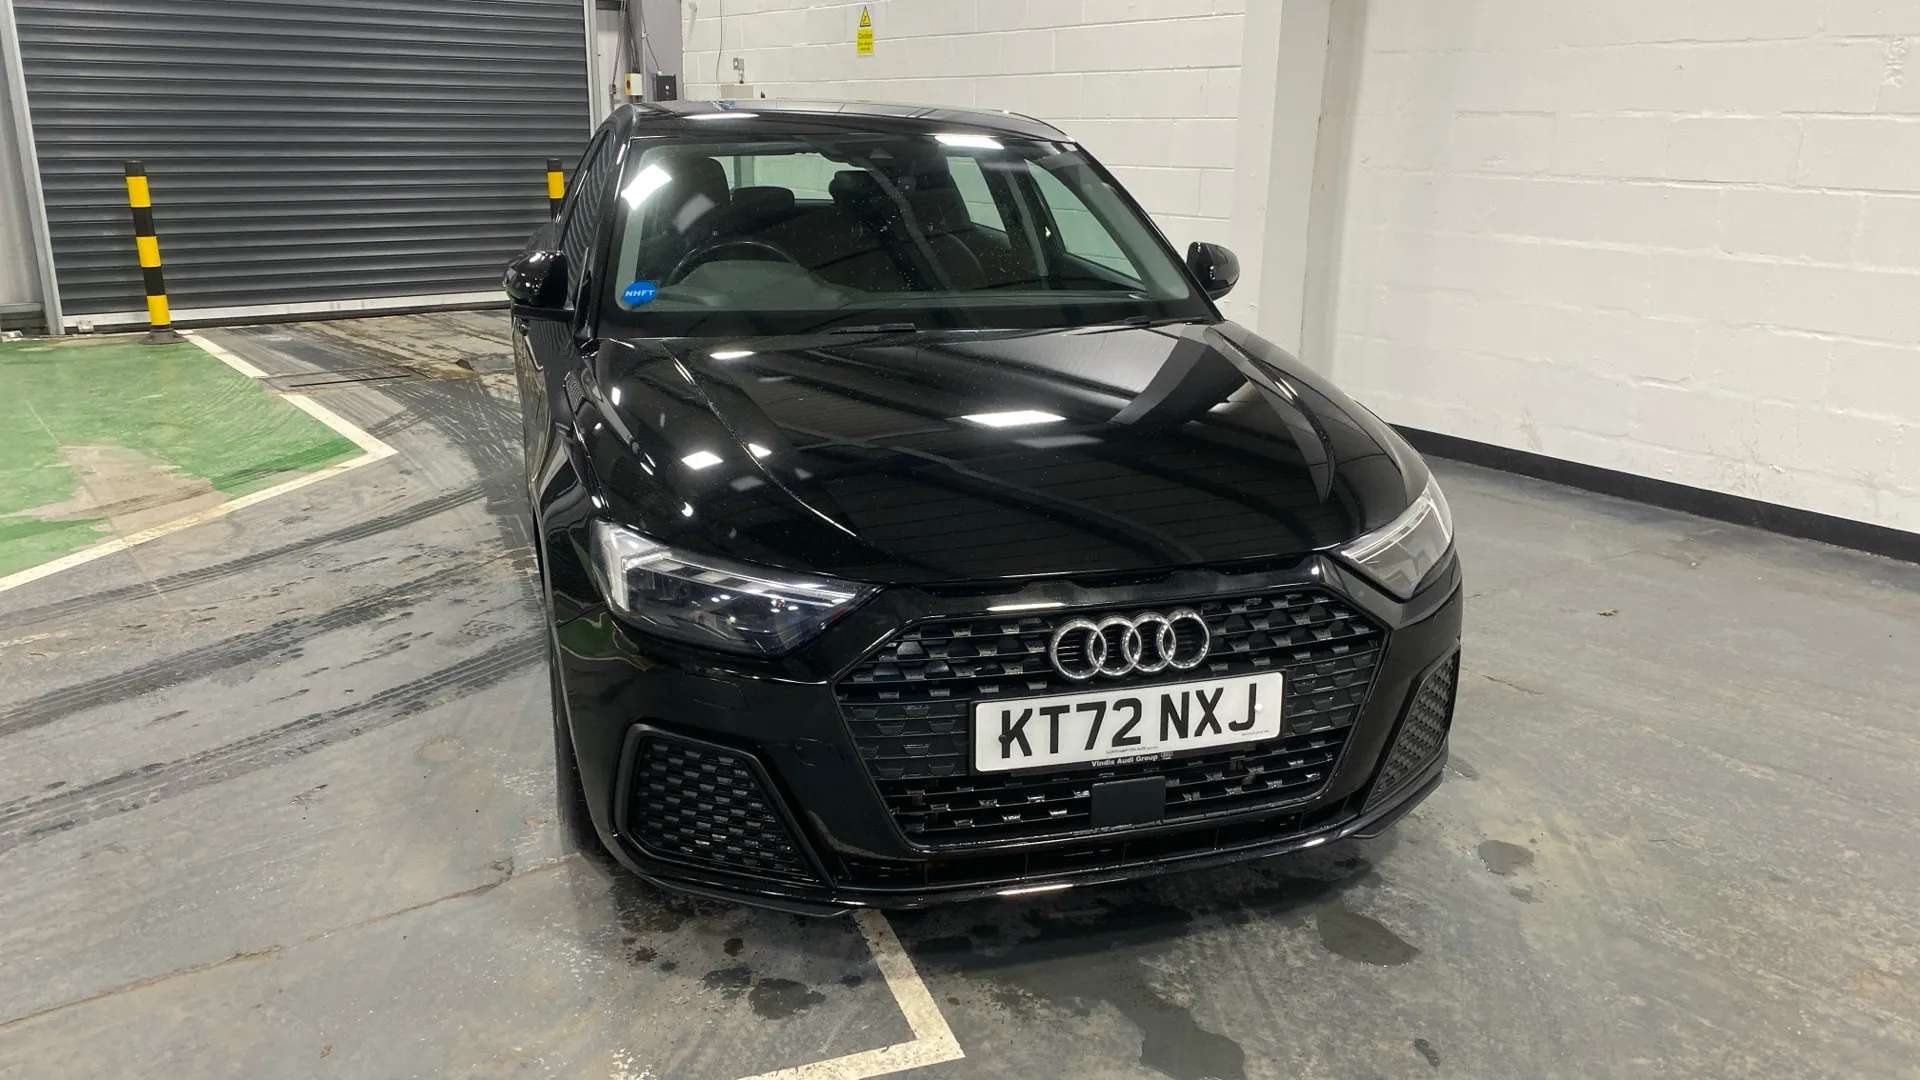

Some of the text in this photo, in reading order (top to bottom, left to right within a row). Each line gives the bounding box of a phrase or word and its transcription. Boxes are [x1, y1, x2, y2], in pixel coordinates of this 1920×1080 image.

[625, 289, 655, 297] NHFT
[1001, 683, 1257, 759] KT72 NXJ
[1091, 758, 1115, 767] Vindis
[1117, 756, 1134, 765] Audi
[1136, 754, 1158, 762] Group
